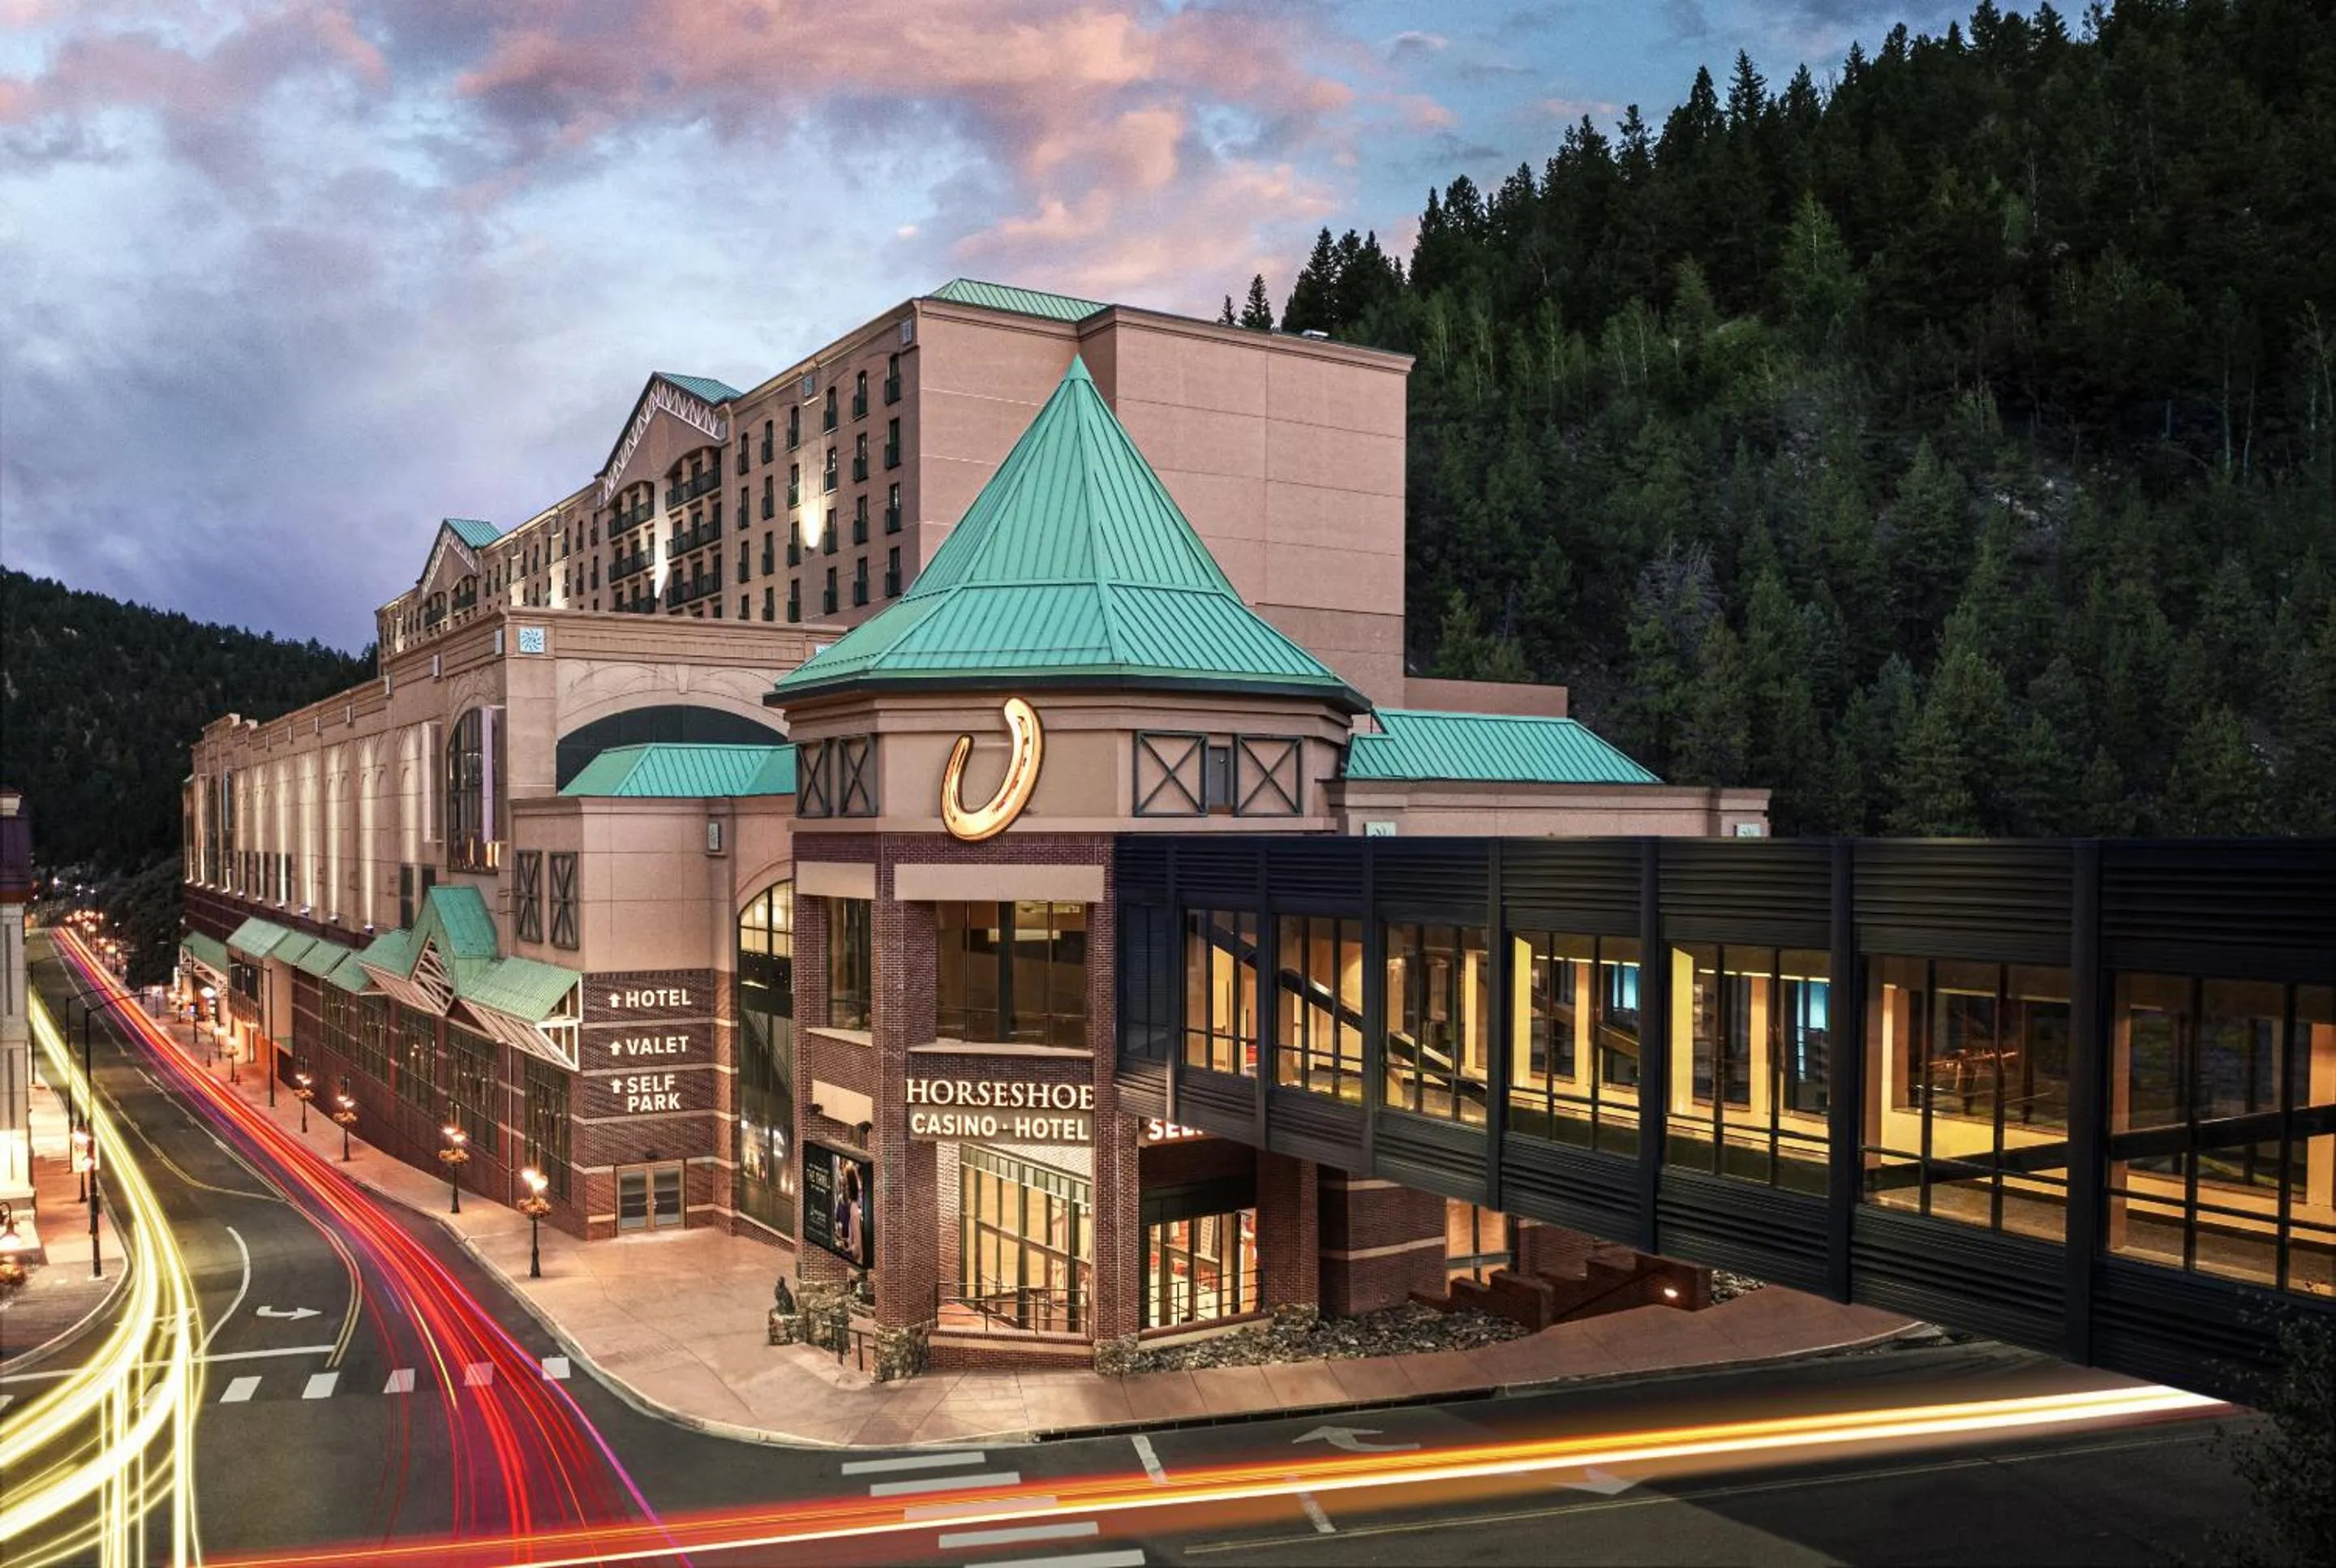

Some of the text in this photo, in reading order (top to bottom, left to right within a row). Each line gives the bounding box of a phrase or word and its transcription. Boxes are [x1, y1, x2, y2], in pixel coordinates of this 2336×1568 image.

[625, 989, 692, 1008] HOTEL
[625, 1036, 689, 1055] VALET
[626, 1075, 676, 1094] SELF
[905, 1078, 1094, 1110] HORSESHOE
[627, 1093, 681, 1112] PARK
[911, 1113, 1089, 1141] CASINO HOTEL
[1148, 1119, 1204, 1141] SEL
